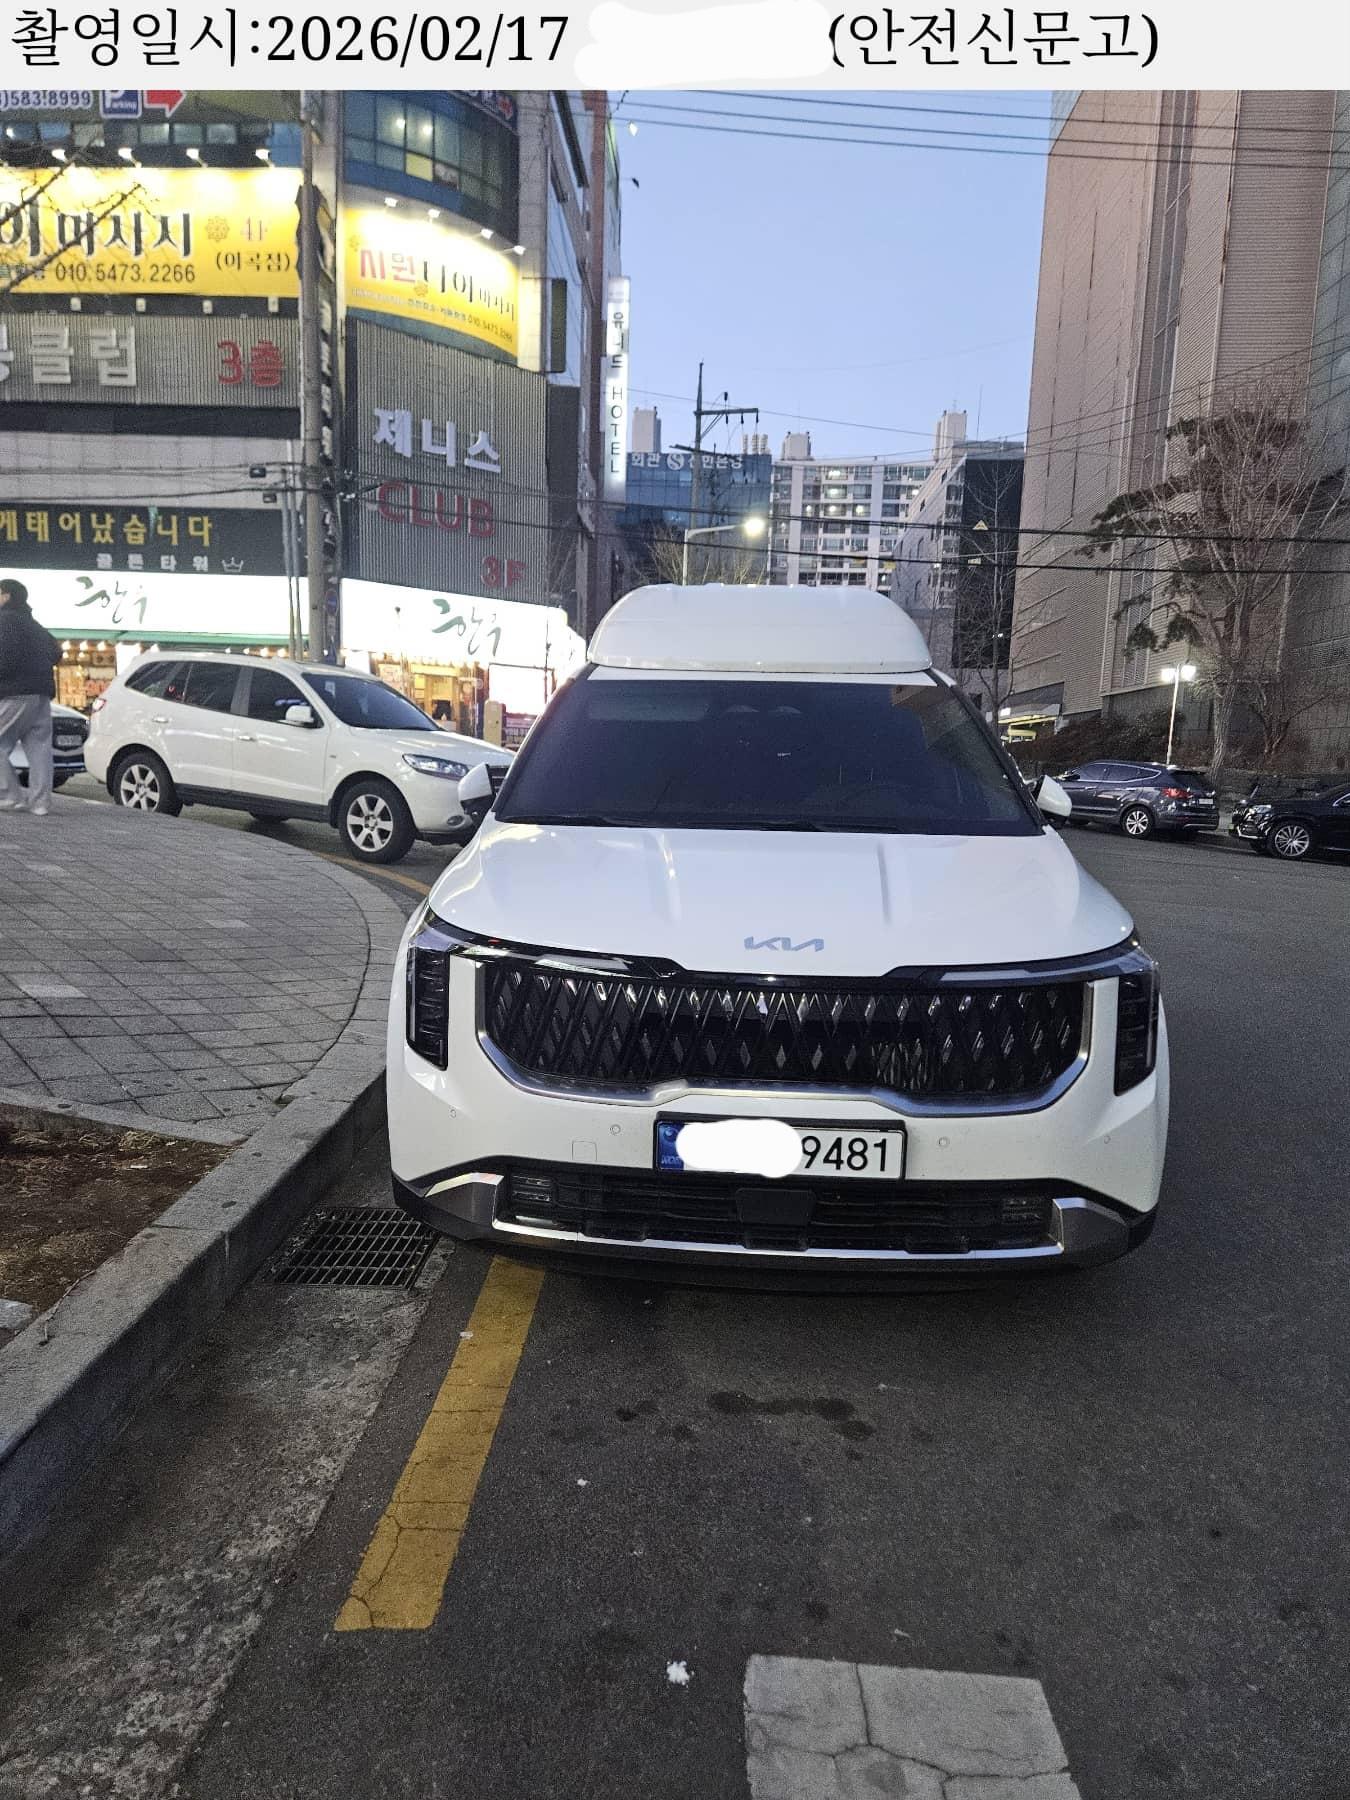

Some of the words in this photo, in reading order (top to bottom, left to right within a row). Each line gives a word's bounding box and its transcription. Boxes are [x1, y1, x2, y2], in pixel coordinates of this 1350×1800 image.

[55, 262, 196, 283] 010.5473.2266
[373, 407, 501, 474] 제니스
[610, 386, 623, 474] HOTEL
[631, 453, 661, 468] 회관
[376, 480, 496, 538] CLUB
[480, 555, 528, 589] 3F
[743, 936, 825, 952] KIA
[801, 1135, 888, 1172] 9481
